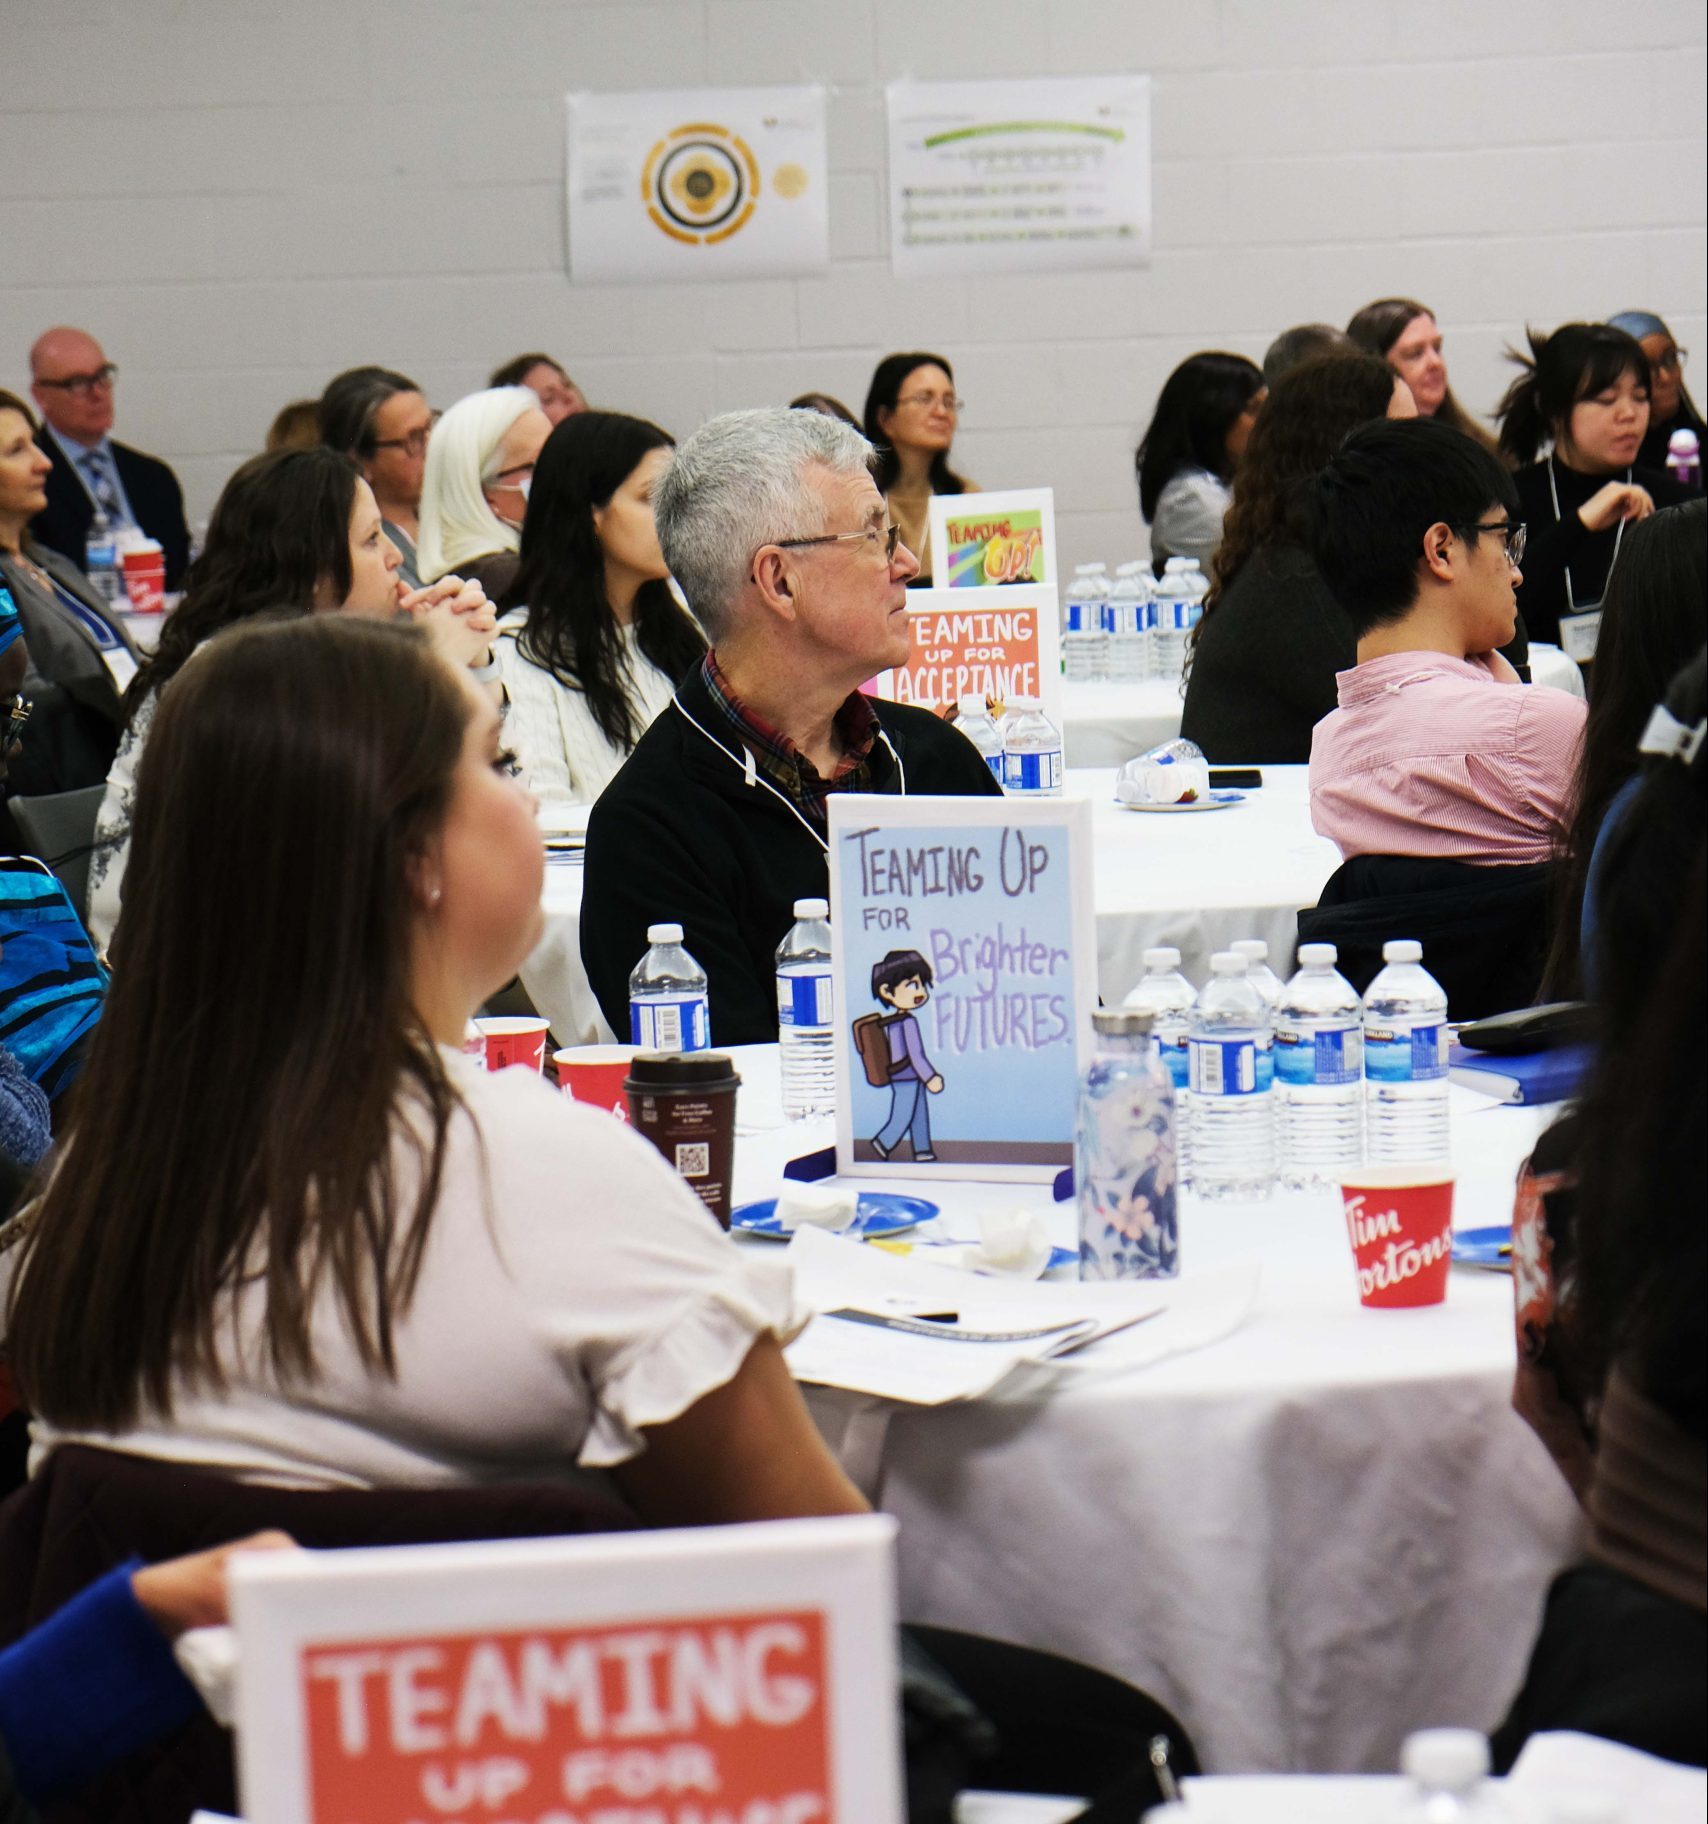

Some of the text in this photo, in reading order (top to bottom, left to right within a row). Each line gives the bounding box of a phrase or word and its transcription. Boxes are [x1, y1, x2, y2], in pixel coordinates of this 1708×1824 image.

[947, 519, 1010, 544] TEAMING
[909, 612, 1033, 646] EAMING
[924, 647, 1006, 663] UP FOR
[897, 662, 1036, 705] ACCEPTANCE
[845, 827, 984, 897] TEAMING
[863, 907, 911, 931] FOR
[930, 922, 1069, 997] Brighter
[1344, 1195, 1402, 1250] Tim
[1357, 1225, 1453, 1297] ortons
[307, 1620, 814, 1757] TEAMING
[420, 1757, 530, 1812] UP
[563, 1742, 720, 1801] FOR
